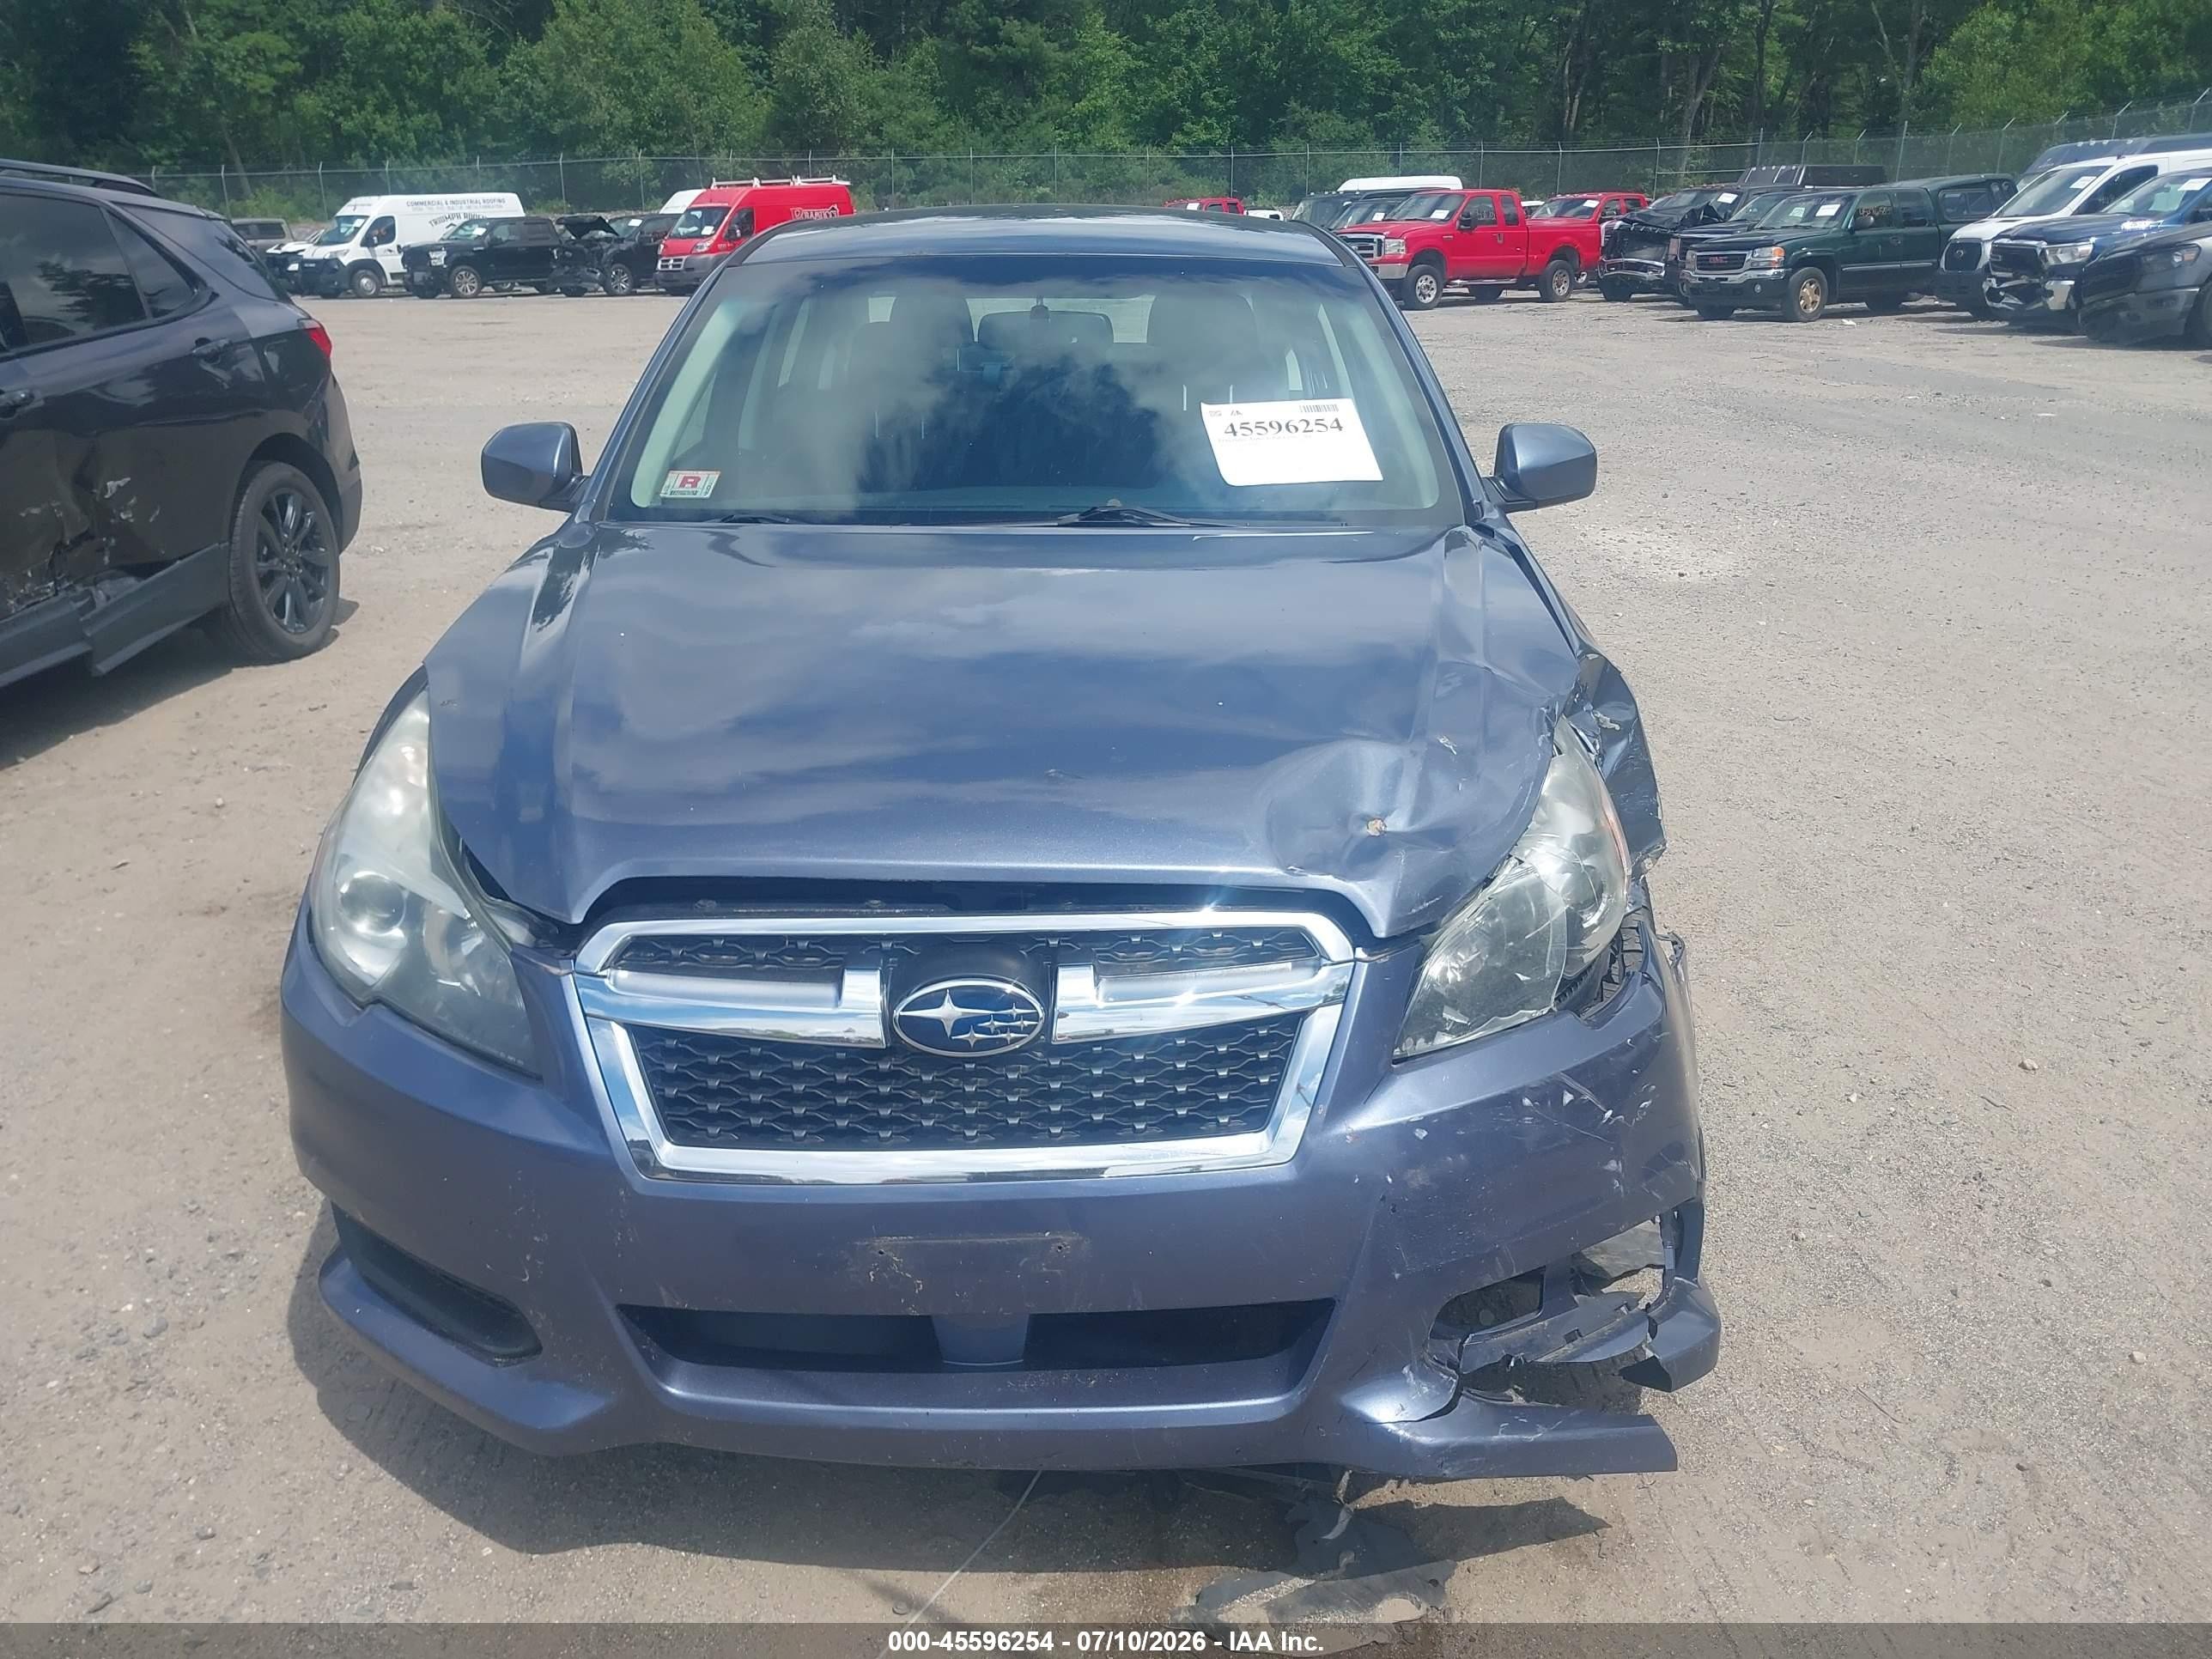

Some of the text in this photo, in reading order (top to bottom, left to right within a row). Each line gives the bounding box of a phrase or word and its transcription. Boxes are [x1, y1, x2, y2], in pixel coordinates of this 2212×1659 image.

[428, 212, 462, 228] TRIUMPH
[1224, 417, 1343, 436] 45596254
[678, 476, 702, 489] R
